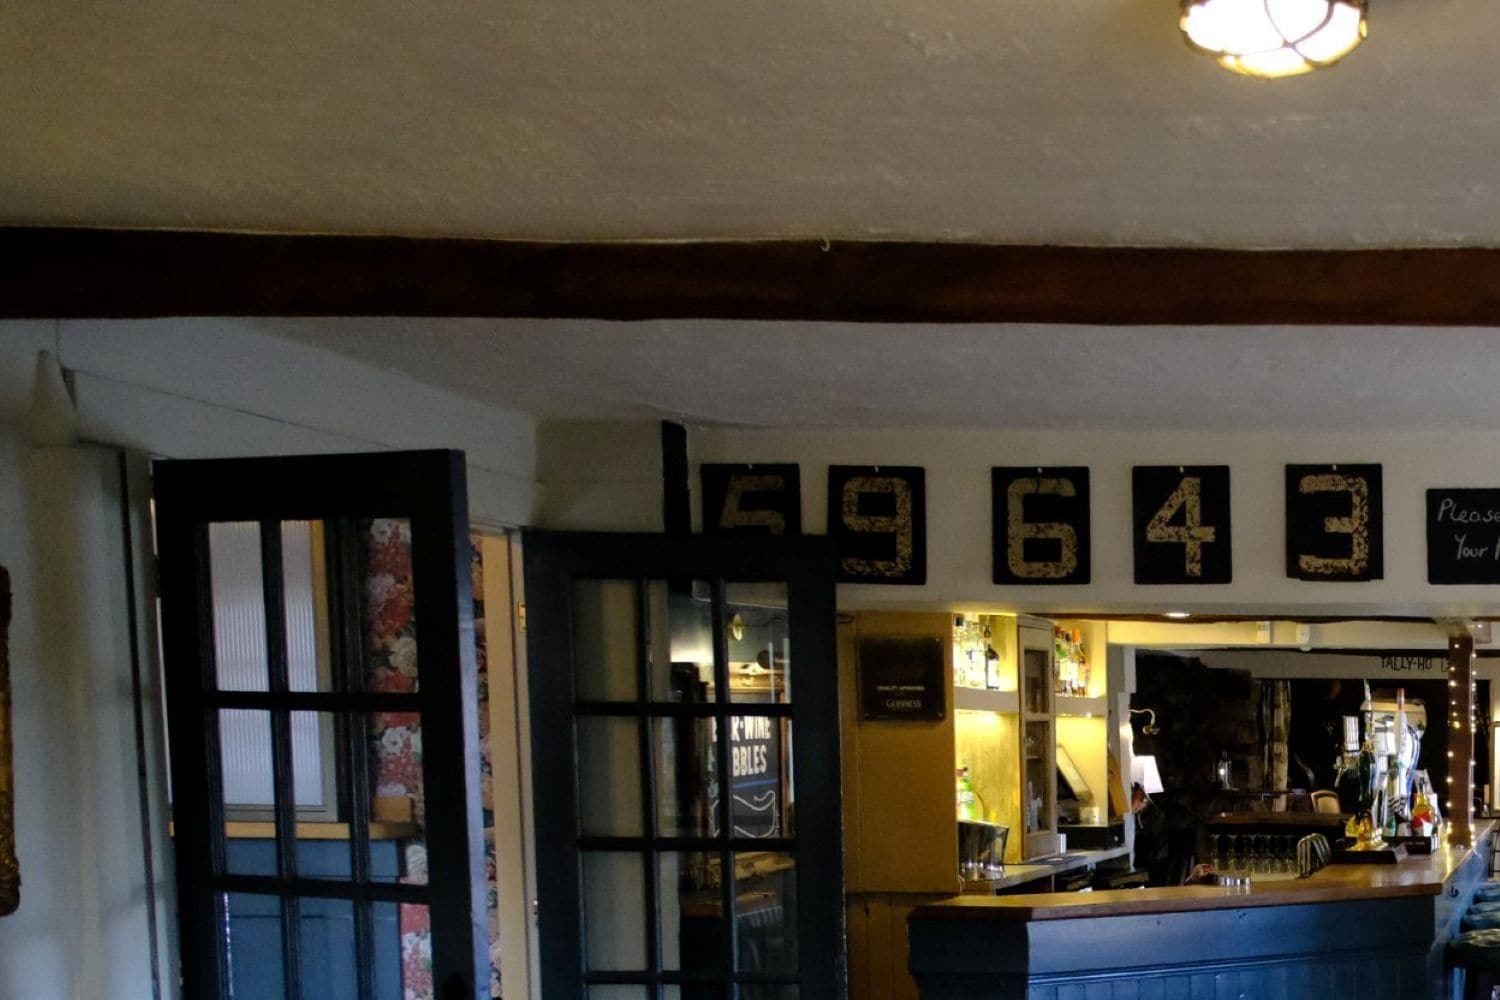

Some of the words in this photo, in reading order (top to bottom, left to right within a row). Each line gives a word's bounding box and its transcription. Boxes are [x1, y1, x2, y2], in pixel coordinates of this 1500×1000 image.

[842, 476, 912, 577] 9
[1007, 477, 1077, 578] 6
[1145, 476, 1216, 577] 4
[1299, 475, 1369, 574] 3
[1454, 533, 1489, 560] Your
